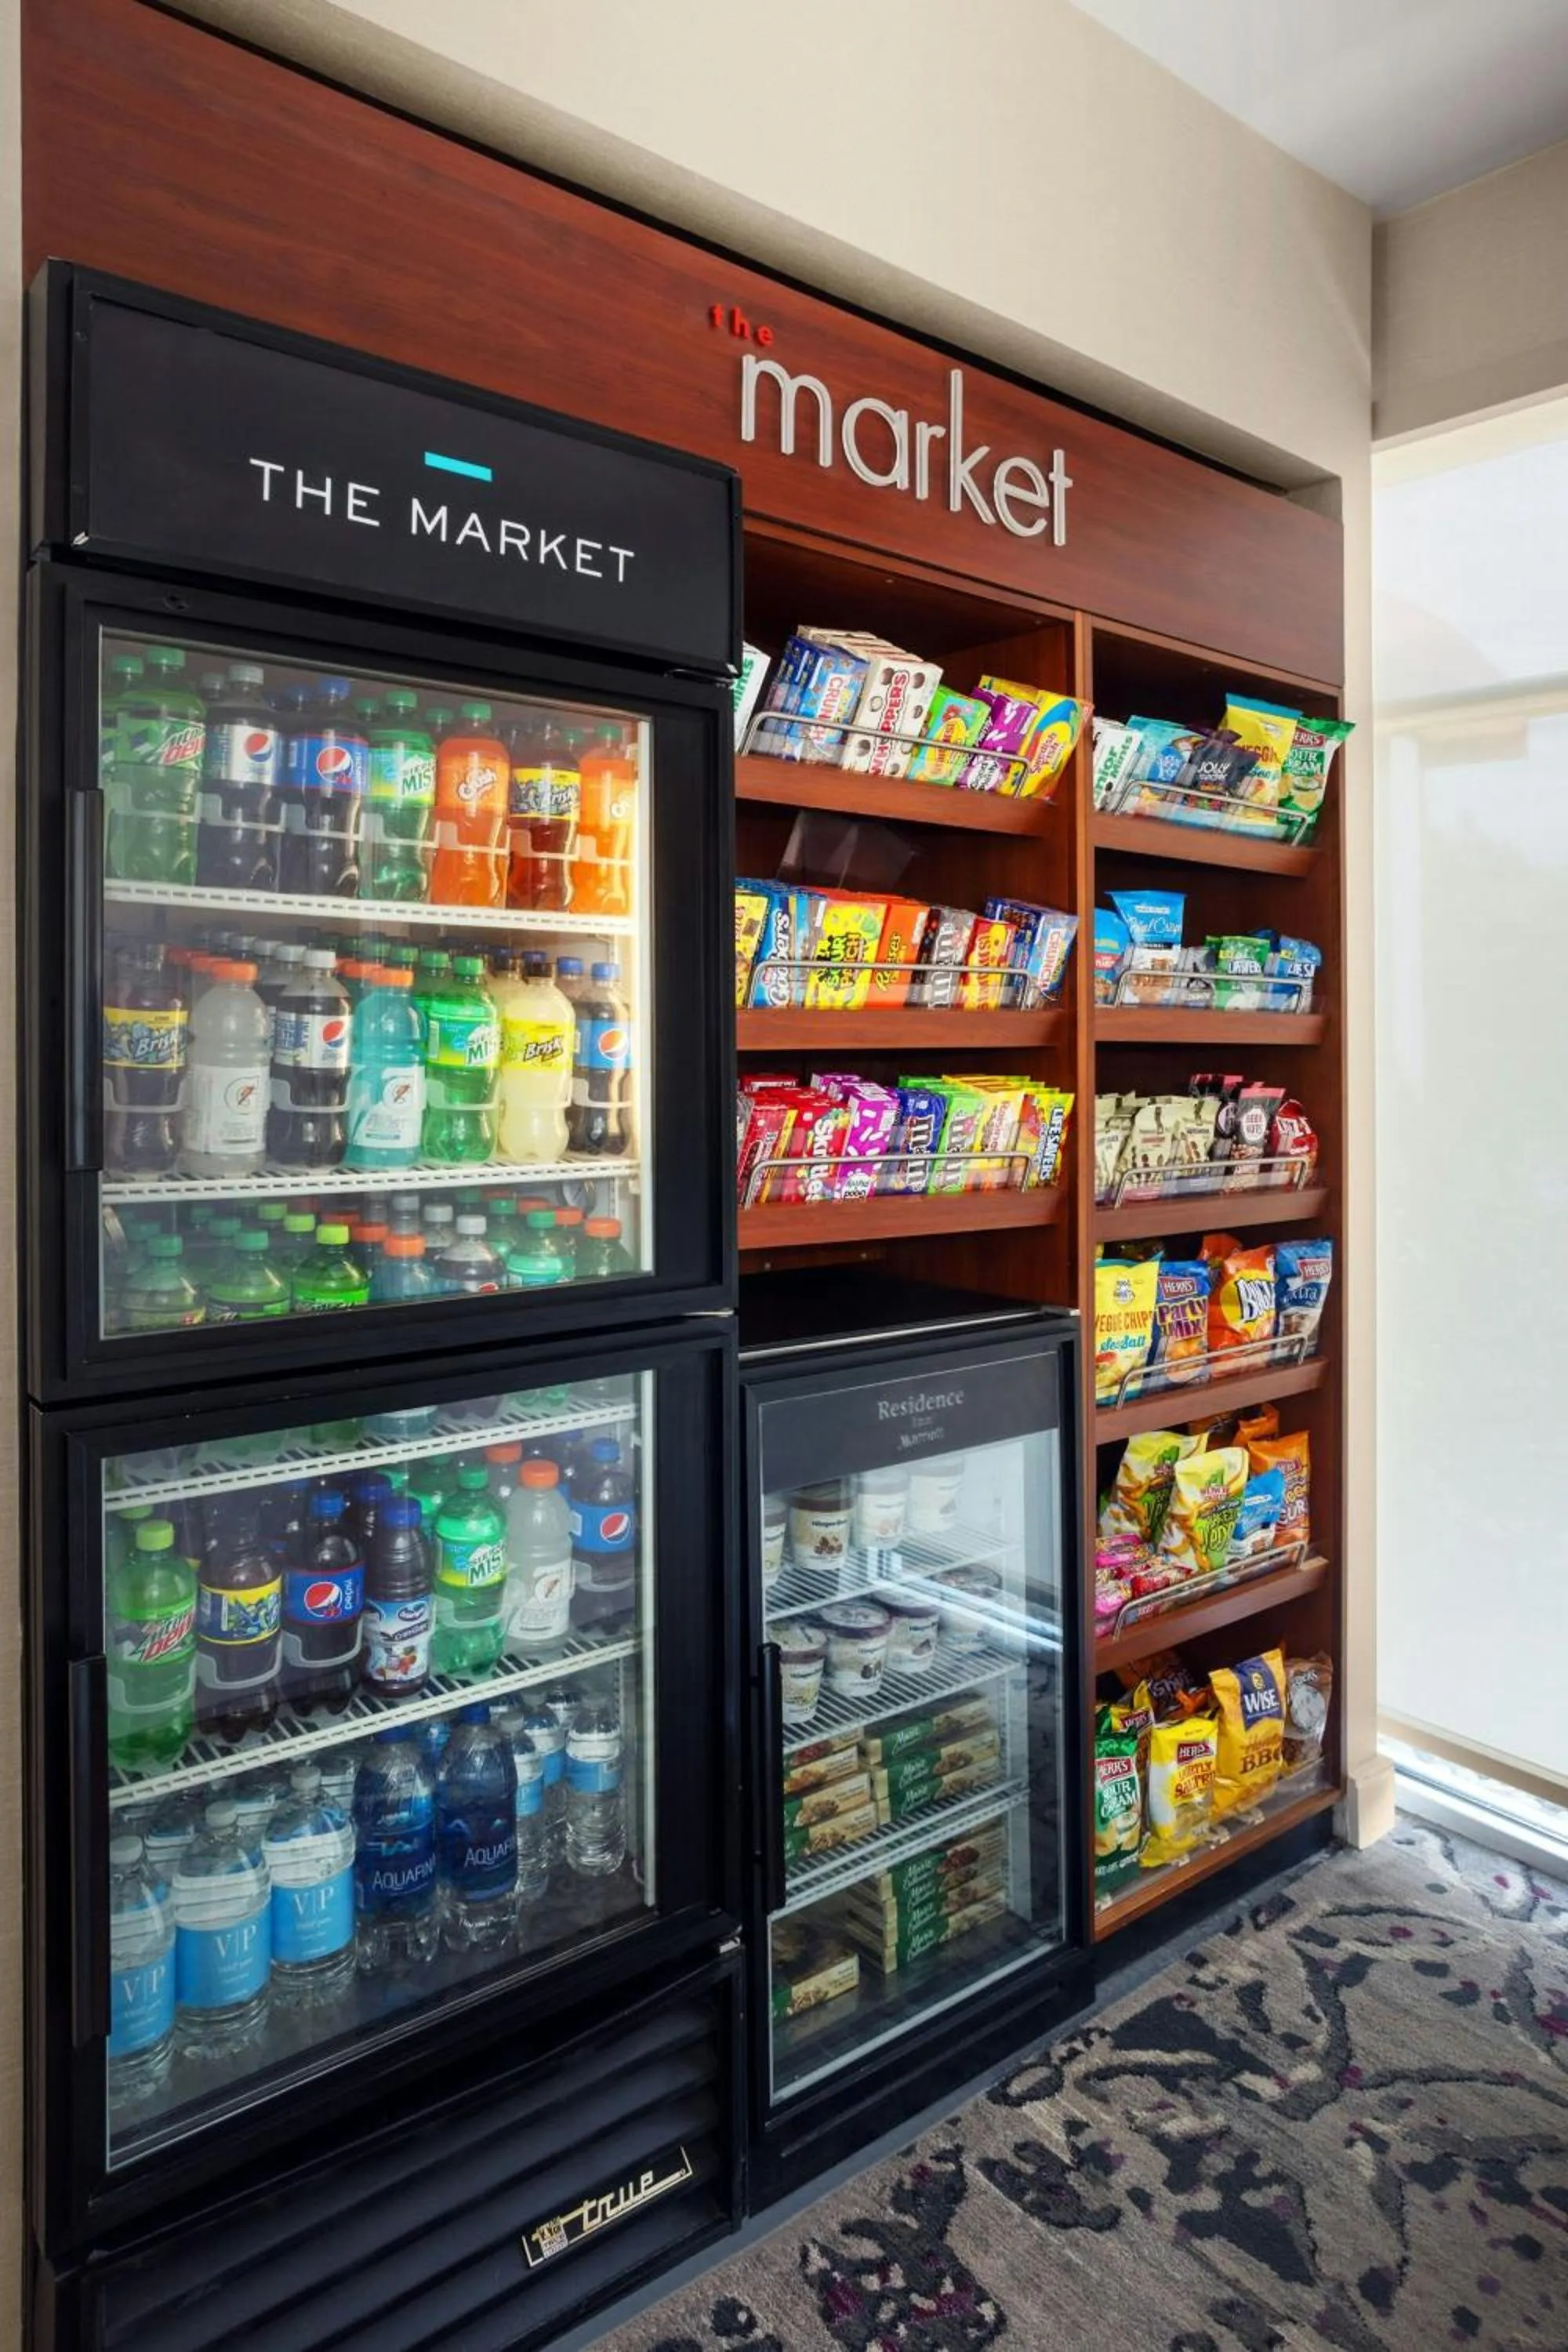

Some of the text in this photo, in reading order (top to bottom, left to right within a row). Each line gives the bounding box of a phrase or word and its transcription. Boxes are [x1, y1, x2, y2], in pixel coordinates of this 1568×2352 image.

[709, 304, 775, 348] the
[740, 353, 1074, 547] market
[249, 458, 636, 584] THE MARKET
[869, 671, 909, 776] WHPPERS
[1197, 760, 1232, 774] JOLLY
[826, 935, 848, 986] SUR
[1037, 931, 1061, 993] CRUNCH
[134, 1028, 180, 1057] Brisk
[523, 1035, 564, 1062] Brisk
[1158, 1298, 1207, 1323] Party
[877, 1390, 965, 1421] Residence
[1243, 1688, 1279, 1714] WISE
